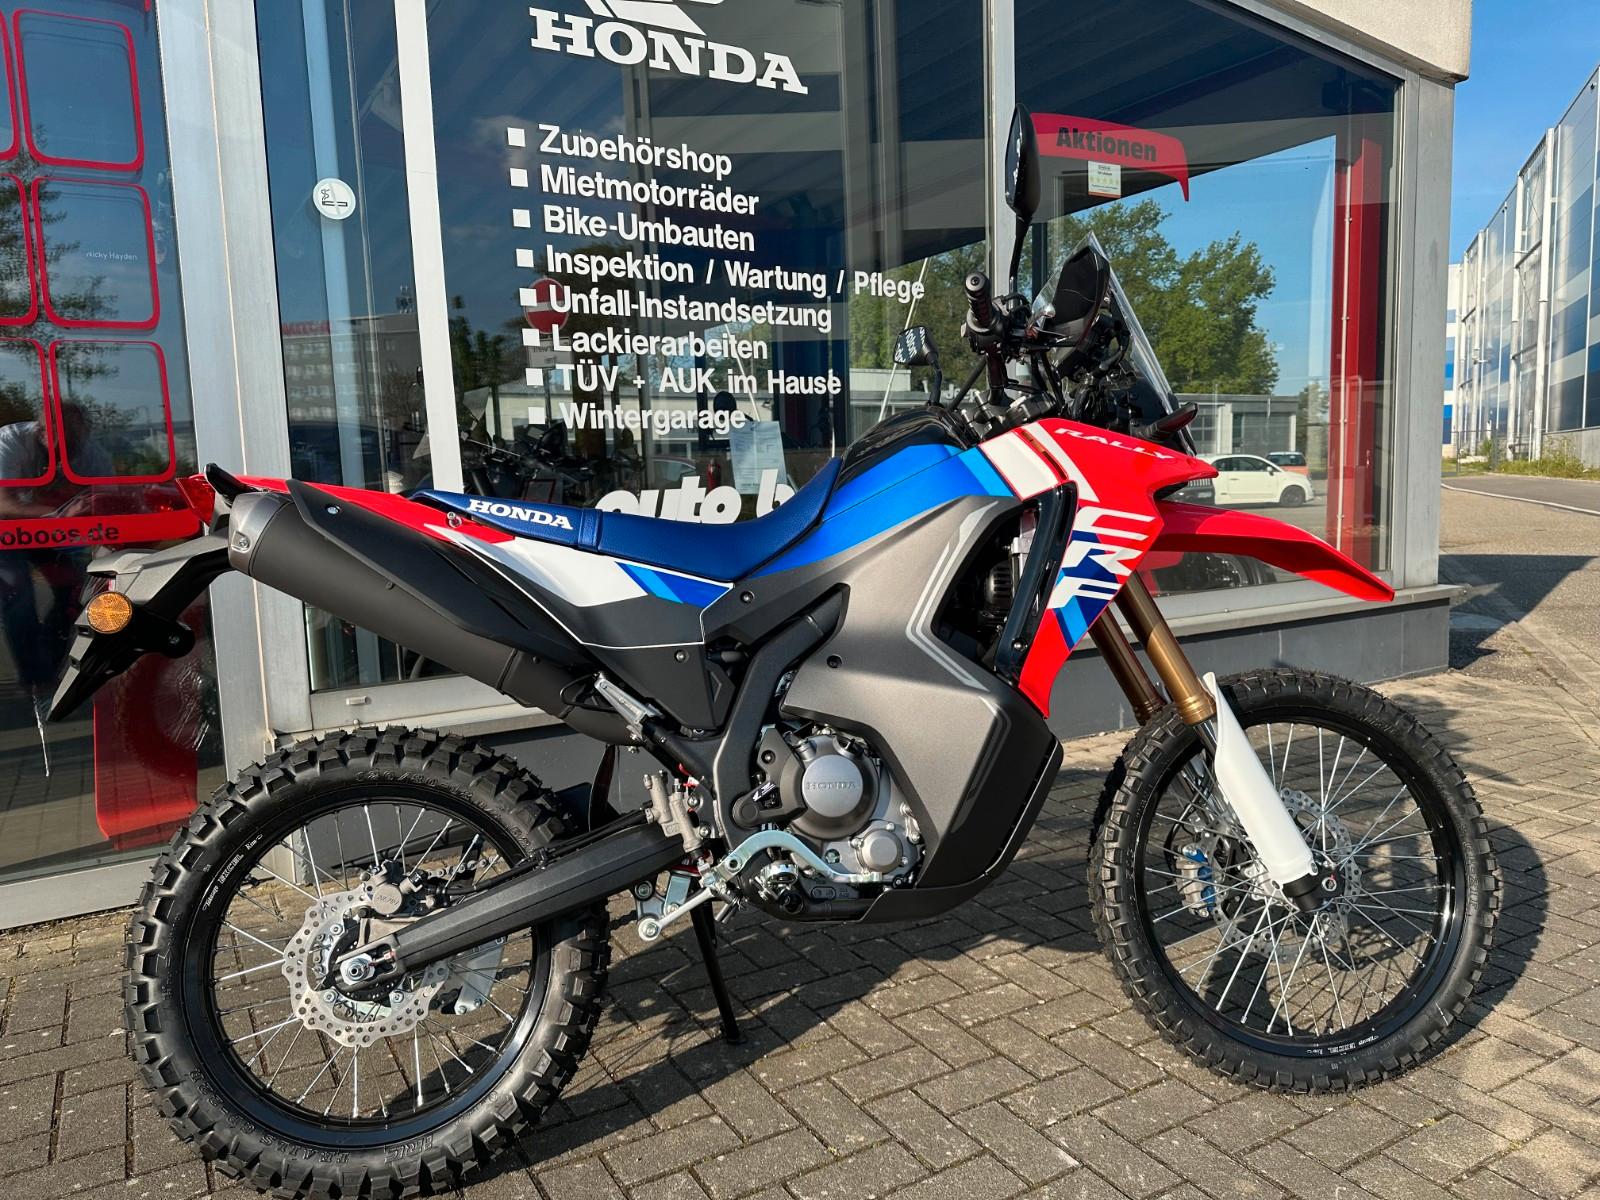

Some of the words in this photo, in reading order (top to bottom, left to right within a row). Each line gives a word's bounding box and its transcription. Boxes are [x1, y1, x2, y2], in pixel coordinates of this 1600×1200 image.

[529, 7, 808, 94] HONDA
[538, 124, 732, 180] Zubehörshop
[1056, 127, 1157, 162] Aktionen
[540, 164, 759, 216] Mietmotorräder
[543, 205, 755, 252] Bike-Umbauten
[109, 251, 138, 261] Hayden
[546, 245, 694, 284] Inspektion
[724, 260, 827, 298] Wartung
[854, 271, 926, 303] Pflege
[549, 284, 832, 333] Unfall-Instandsetzung
[552, 323, 768, 359] Lackierarbeiten
[555, 359, 619, 392] TÜV
[659, 367, 717, 394] AUK
[727, 368, 758, 394] im
[767, 369, 842, 395] Hause
[559, 402, 746, 435] Wintergarage
[1054, 427, 1175, 460] RALLY
[469, 499, 574, 531] HONDA
[806, 781, 857, 791] HONDA
